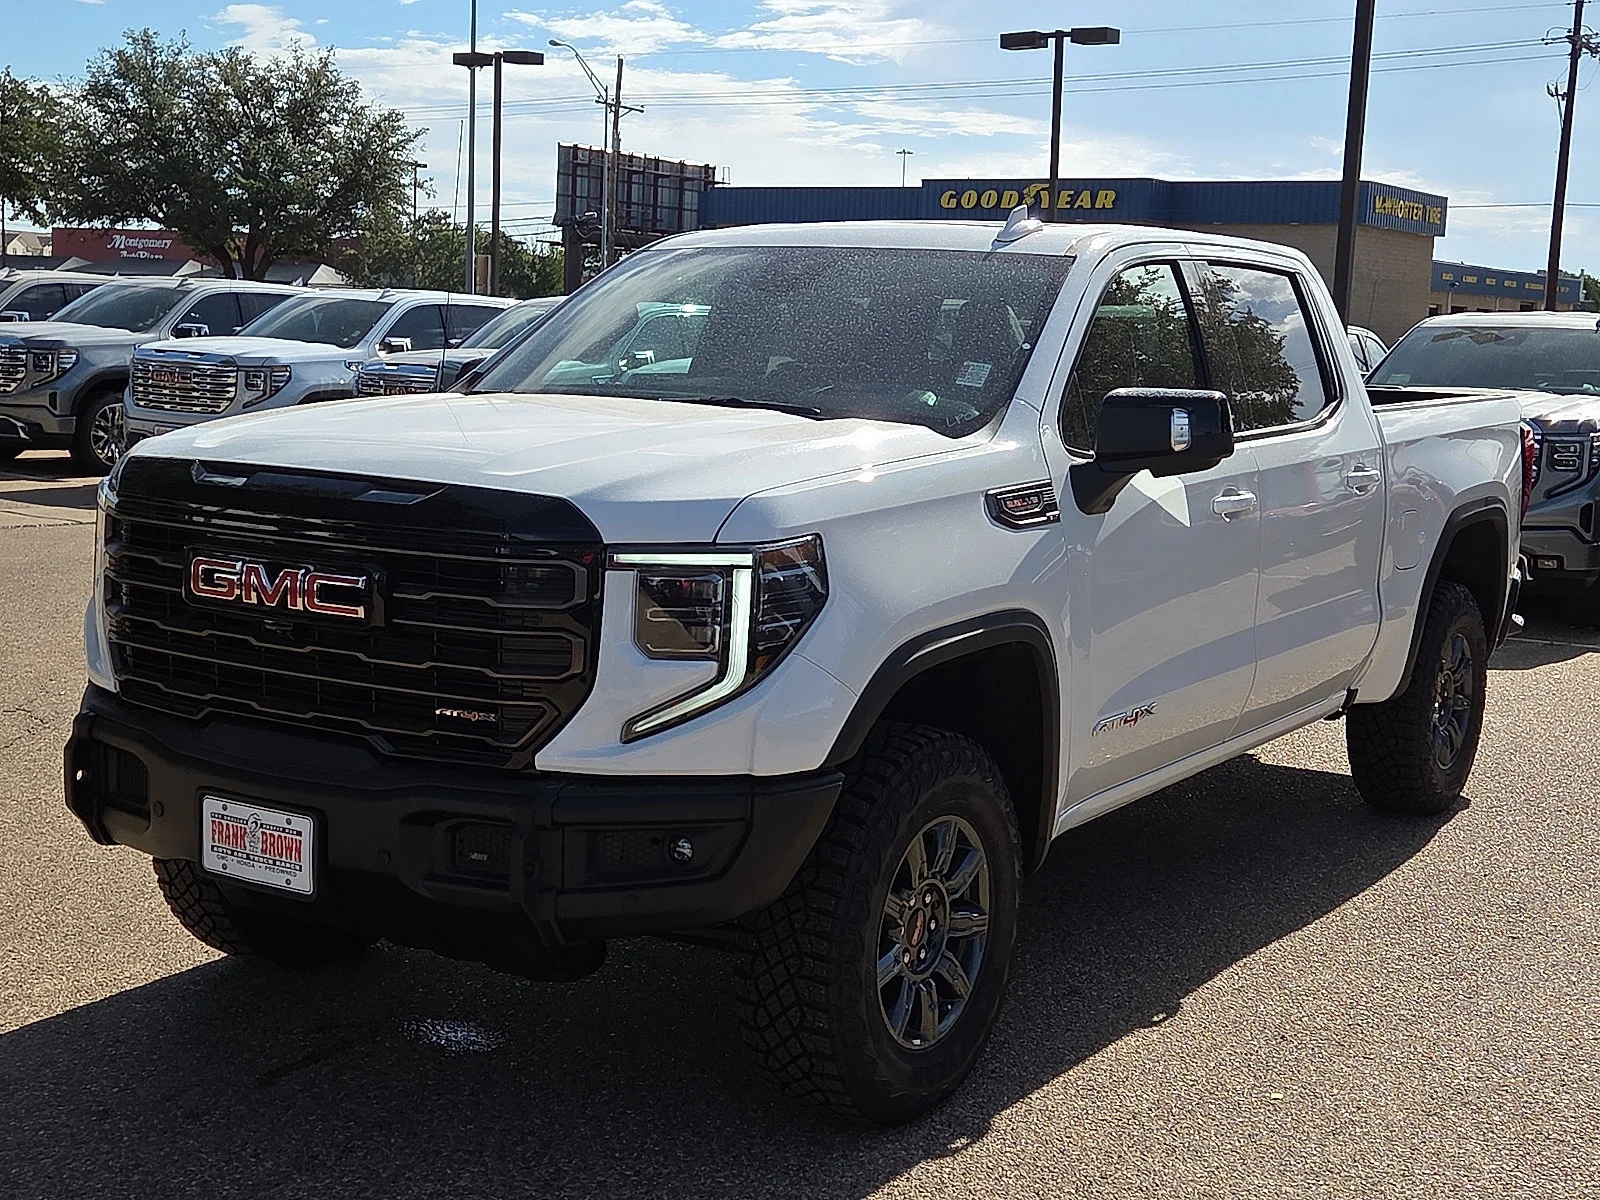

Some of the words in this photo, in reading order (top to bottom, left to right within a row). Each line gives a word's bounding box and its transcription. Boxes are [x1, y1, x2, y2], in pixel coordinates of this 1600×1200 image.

[107, 234, 172, 249] Montgomery
[153, 369, 190, 383] GMC
[191, 556, 366, 619] GMC
[1091, 701, 1158, 737] AT4X
[211, 819, 247, 851] FRANK
[261, 830, 302, 863] BROWN
[213, 846, 232, 855] AUTO
